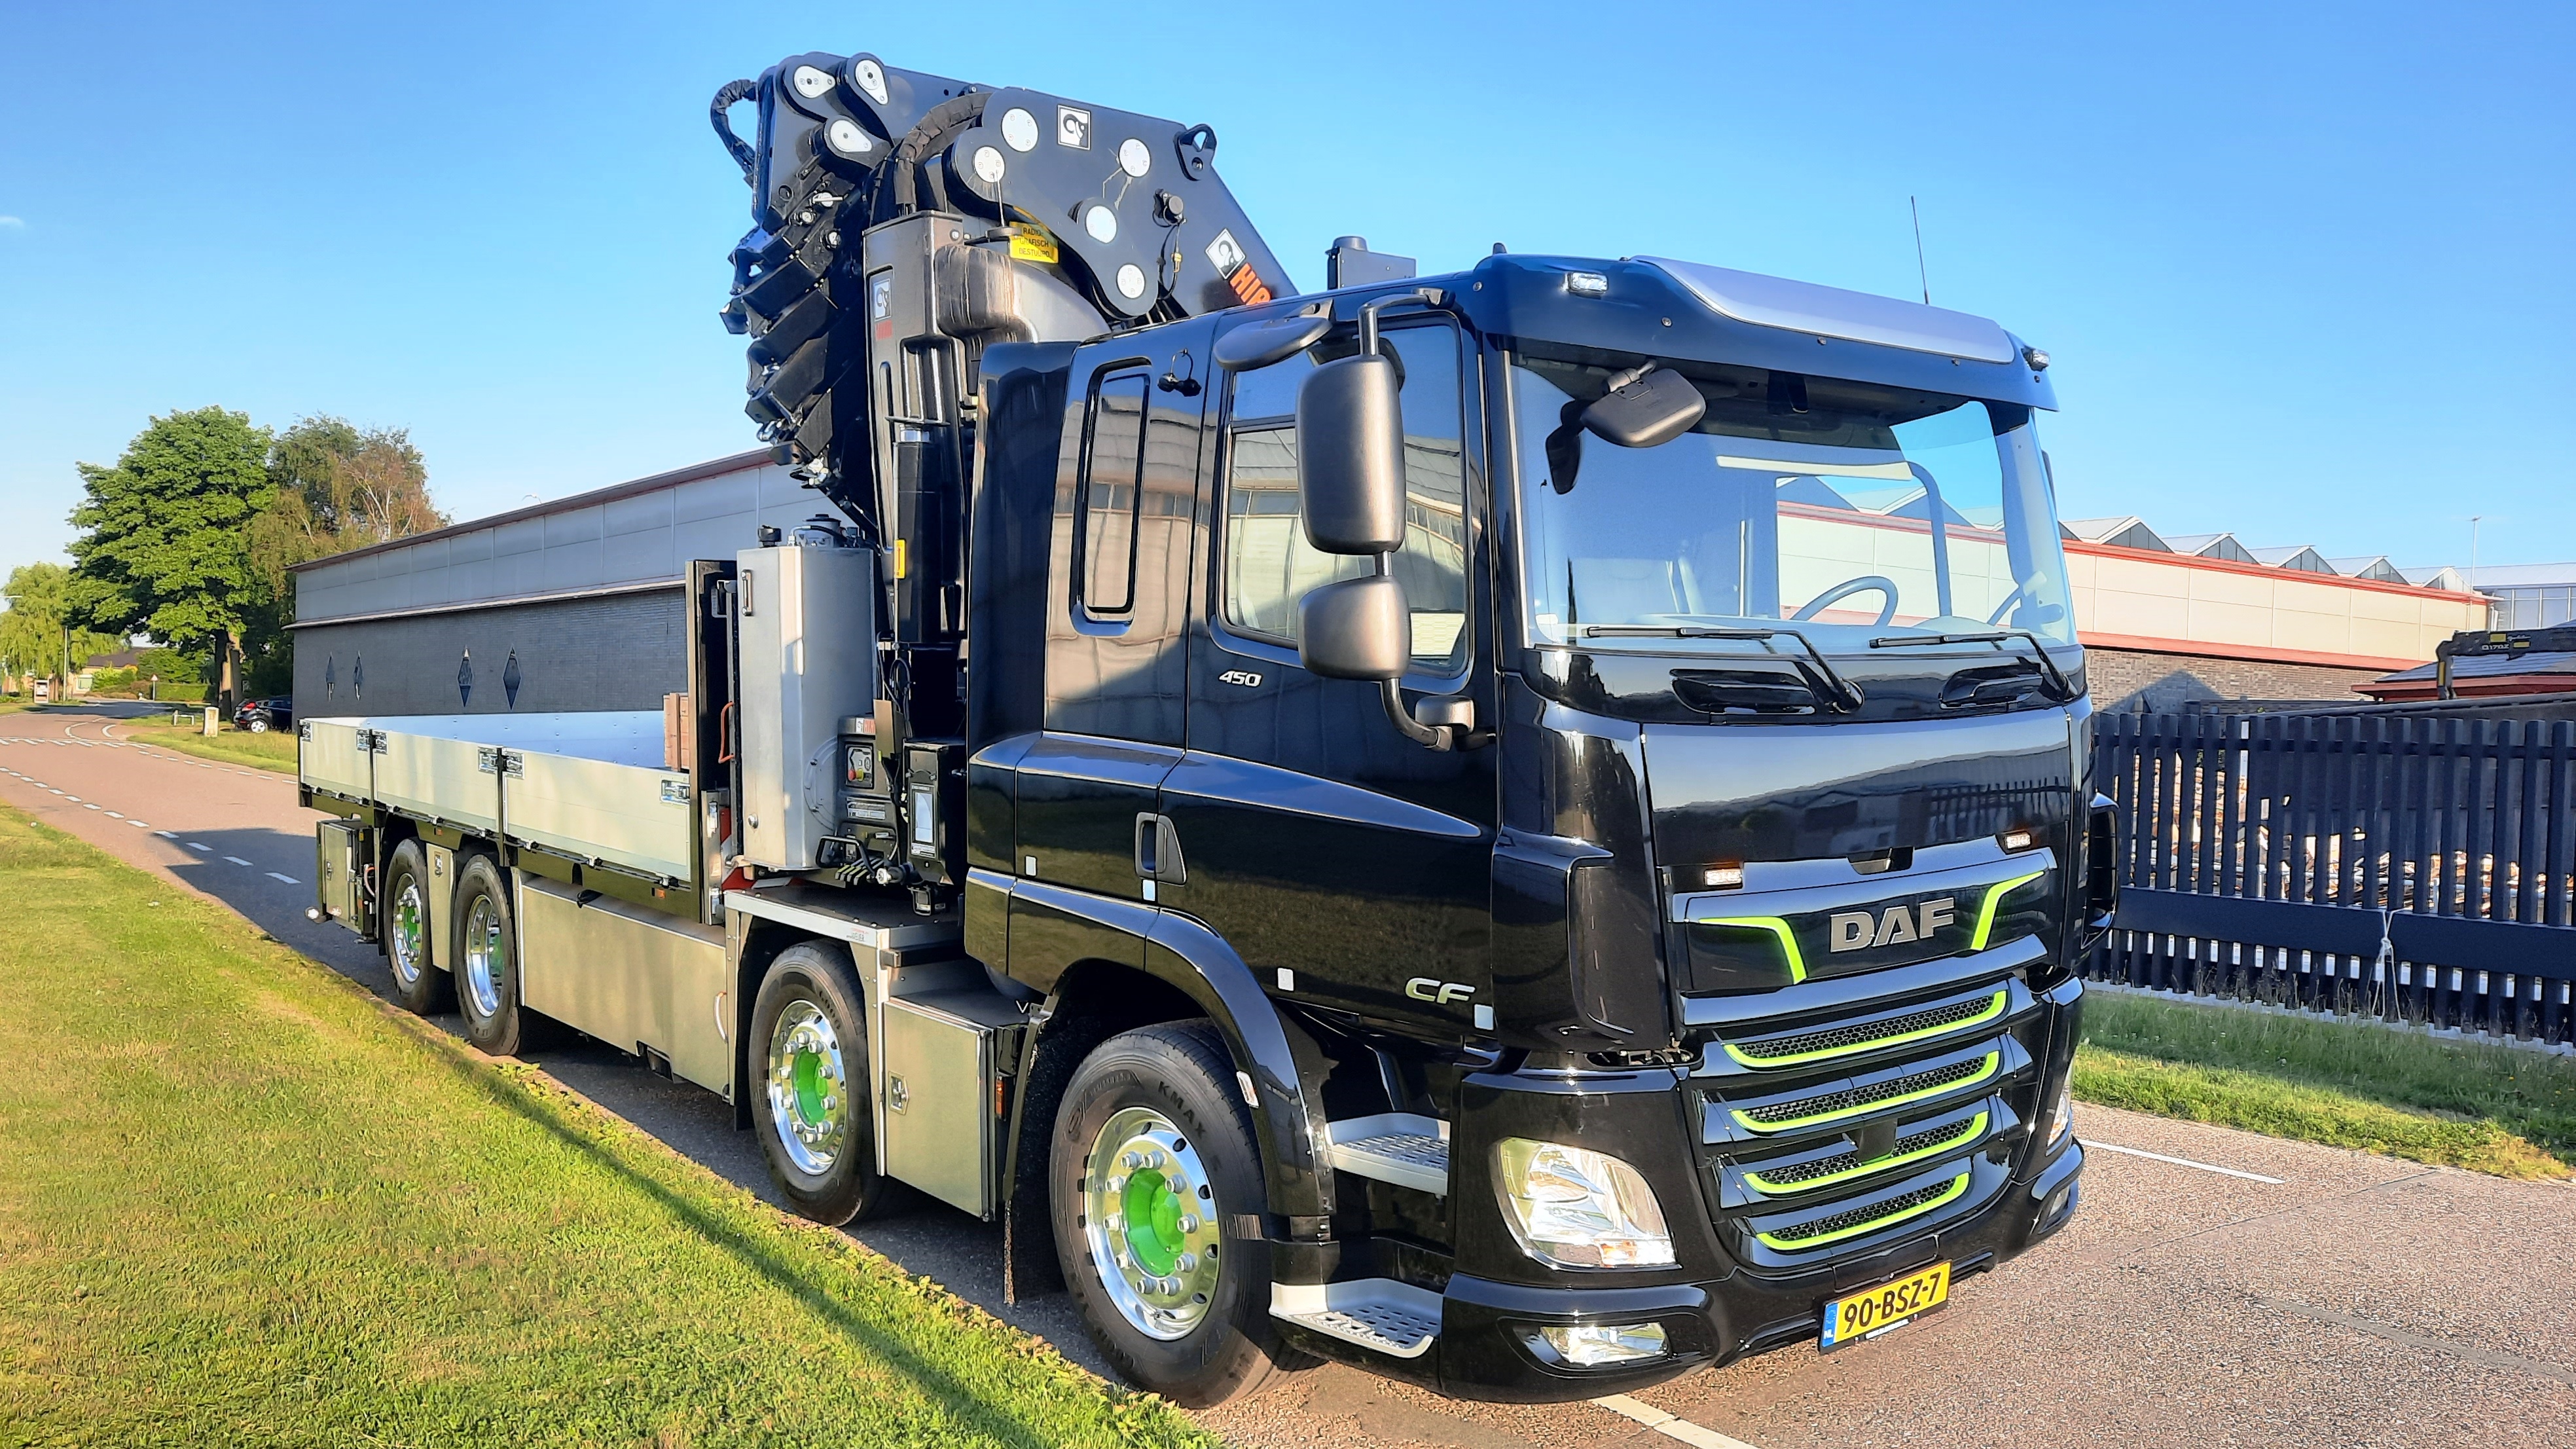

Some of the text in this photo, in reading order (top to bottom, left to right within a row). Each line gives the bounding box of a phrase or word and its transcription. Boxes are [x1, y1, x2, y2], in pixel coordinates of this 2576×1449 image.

[1219, 670, 1262, 687] 450
[1830, 897, 1955, 953] DAF
[1405, 977, 1476, 1004] CF
[1157, 1080, 1206, 1139] KMAX
[1843, 1272, 1942, 1334] 90-BSZ-7
[1823, 1329, 1834, 1340] NL
